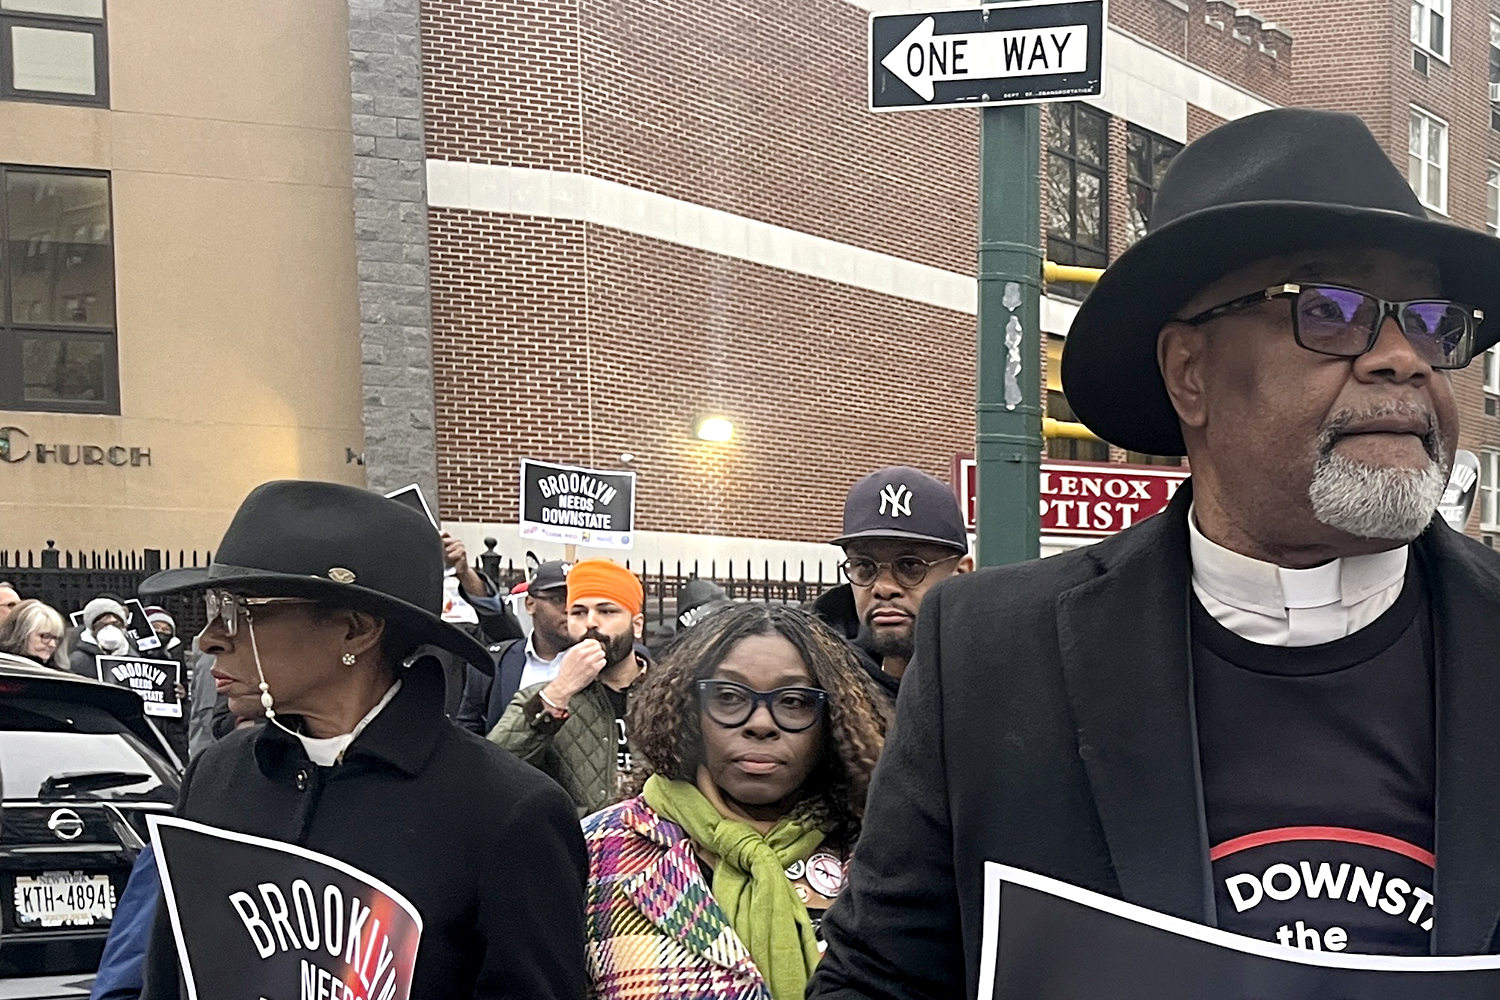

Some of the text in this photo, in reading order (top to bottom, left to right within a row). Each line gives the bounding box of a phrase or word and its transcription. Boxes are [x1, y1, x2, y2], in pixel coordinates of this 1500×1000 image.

[906, 33, 1072, 77] ONE WAY
[538, 473, 617, 506] BROOKLYN
[879, 483, 913, 517] NY
[1040, 472, 1151, 500] LENOX
[559, 495, 594, 511] NEEDS
[542, 507, 611, 529] DOWNSTATE
[111, 663, 168, 686] BROOKLYN
[23, 884, 106, 912] KTH 4894
[1225, 861, 1434, 931] DOWNST
[1276, 920, 1348, 951] the
